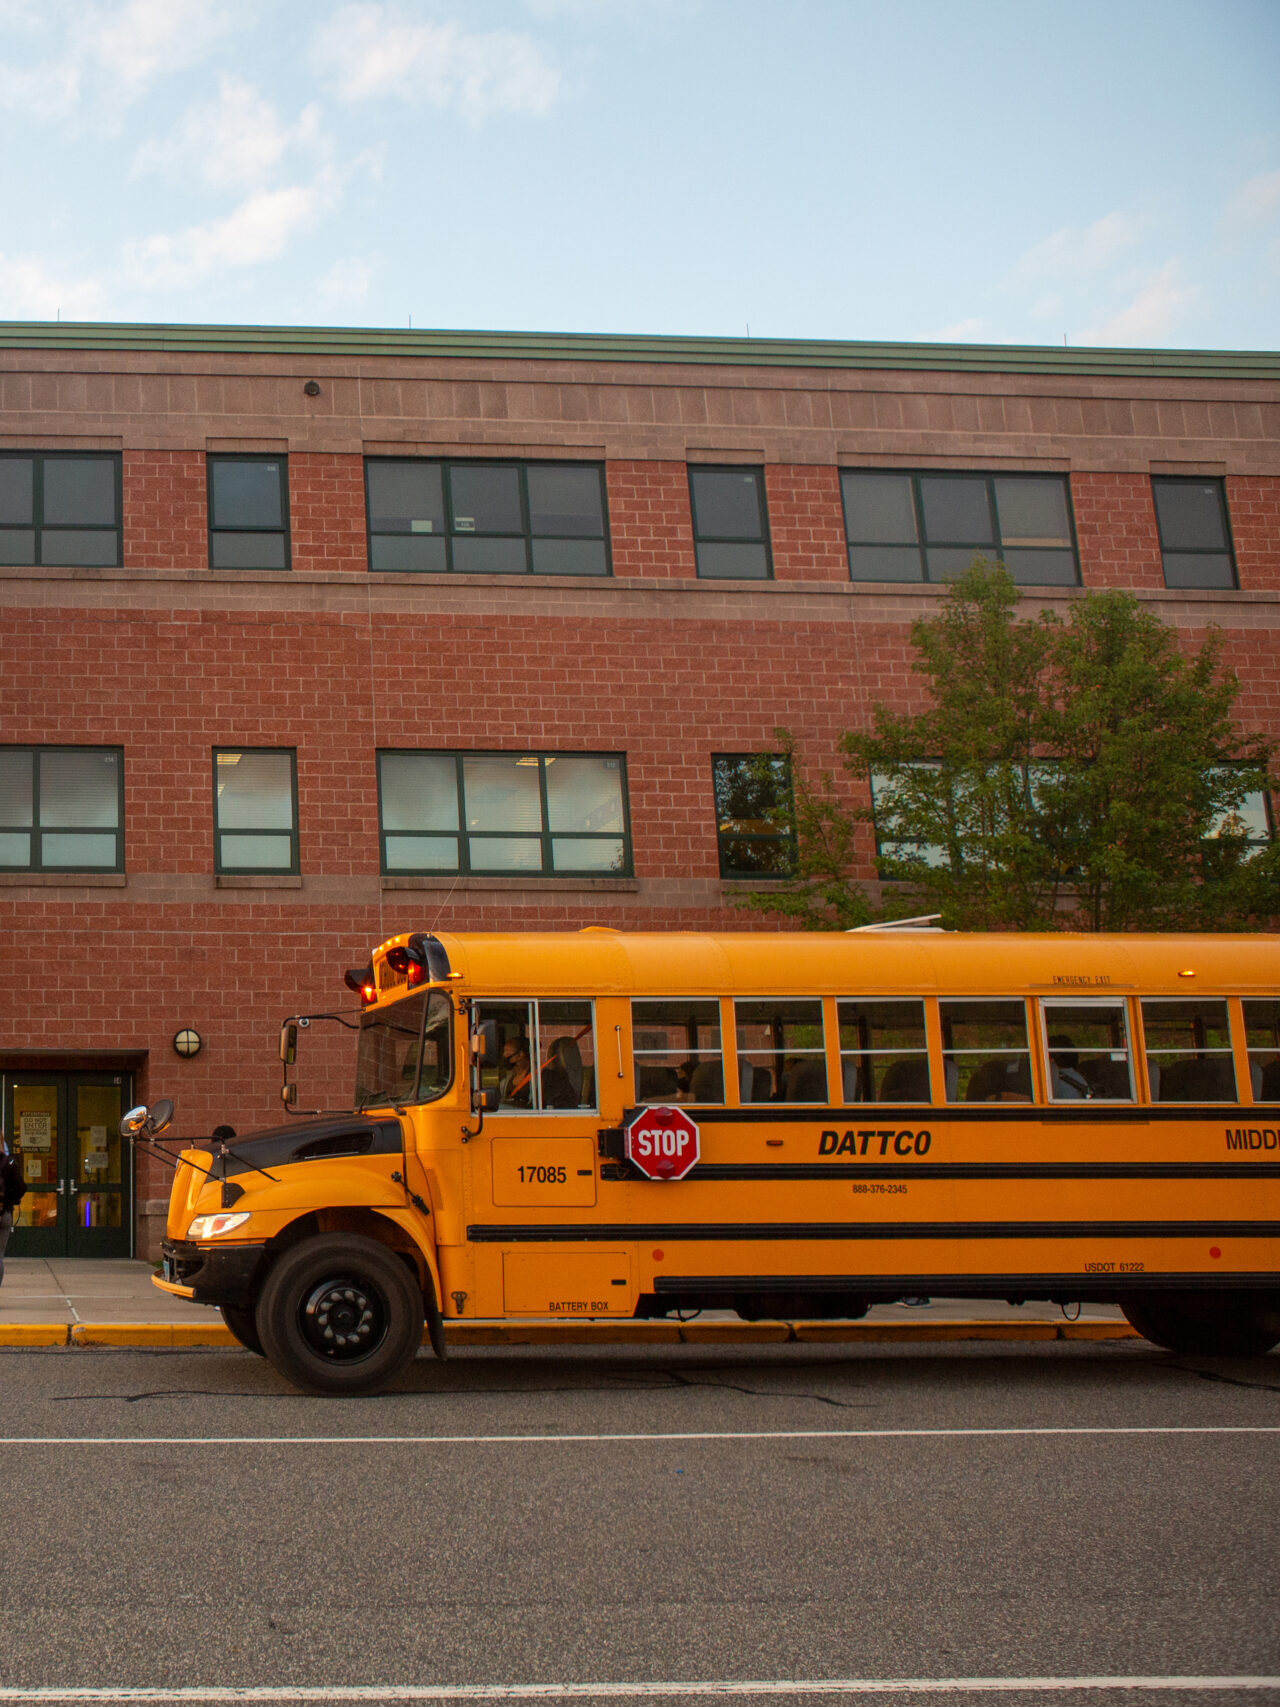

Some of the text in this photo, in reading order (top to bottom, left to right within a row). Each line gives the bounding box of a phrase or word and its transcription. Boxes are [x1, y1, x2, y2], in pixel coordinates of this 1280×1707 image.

[1052, 975, 1112, 985] EMERGENCY EXIT
[638, 1129, 690, 1157] STOP
[818, 1130, 932, 1156] DATTCO
[1225, 1129, 1280, 1150] MIDD
[517, 1165, 567, 1183] 17085
[852, 1184, 908, 1194] 888-376-2345
[1084, 1262, 1145, 1272] USDOT 61222
[549, 1301, 609, 1311] BATTERY BOX
